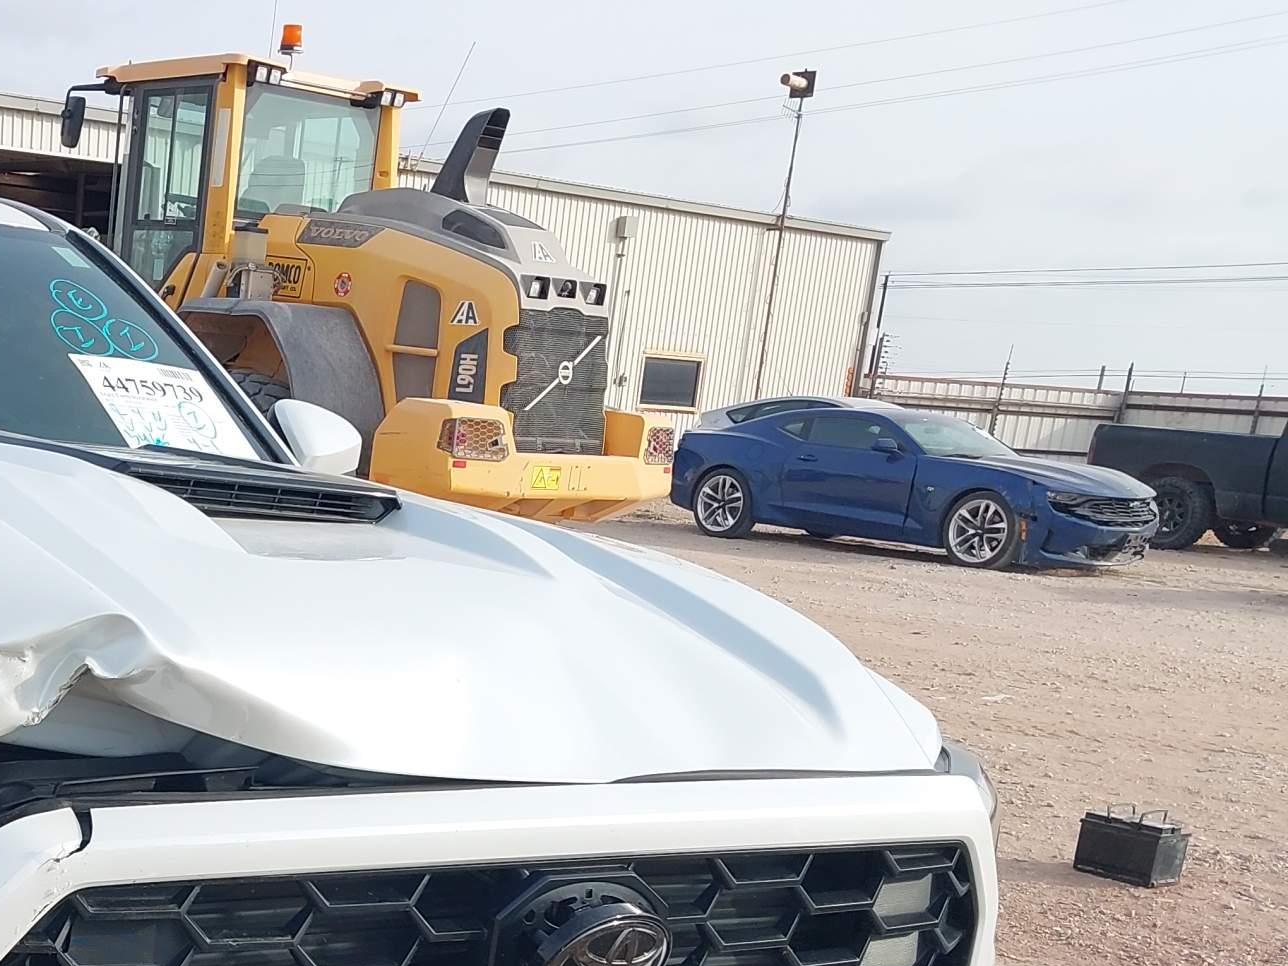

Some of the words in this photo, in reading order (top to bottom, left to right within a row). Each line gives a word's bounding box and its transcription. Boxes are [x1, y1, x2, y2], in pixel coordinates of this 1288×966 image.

[311, 226, 369, 241] VOLVO
[268, 262, 302, 284] OMCO
[455, 353, 479, 393] L90H
[102, 375, 204, 403] 44759739
